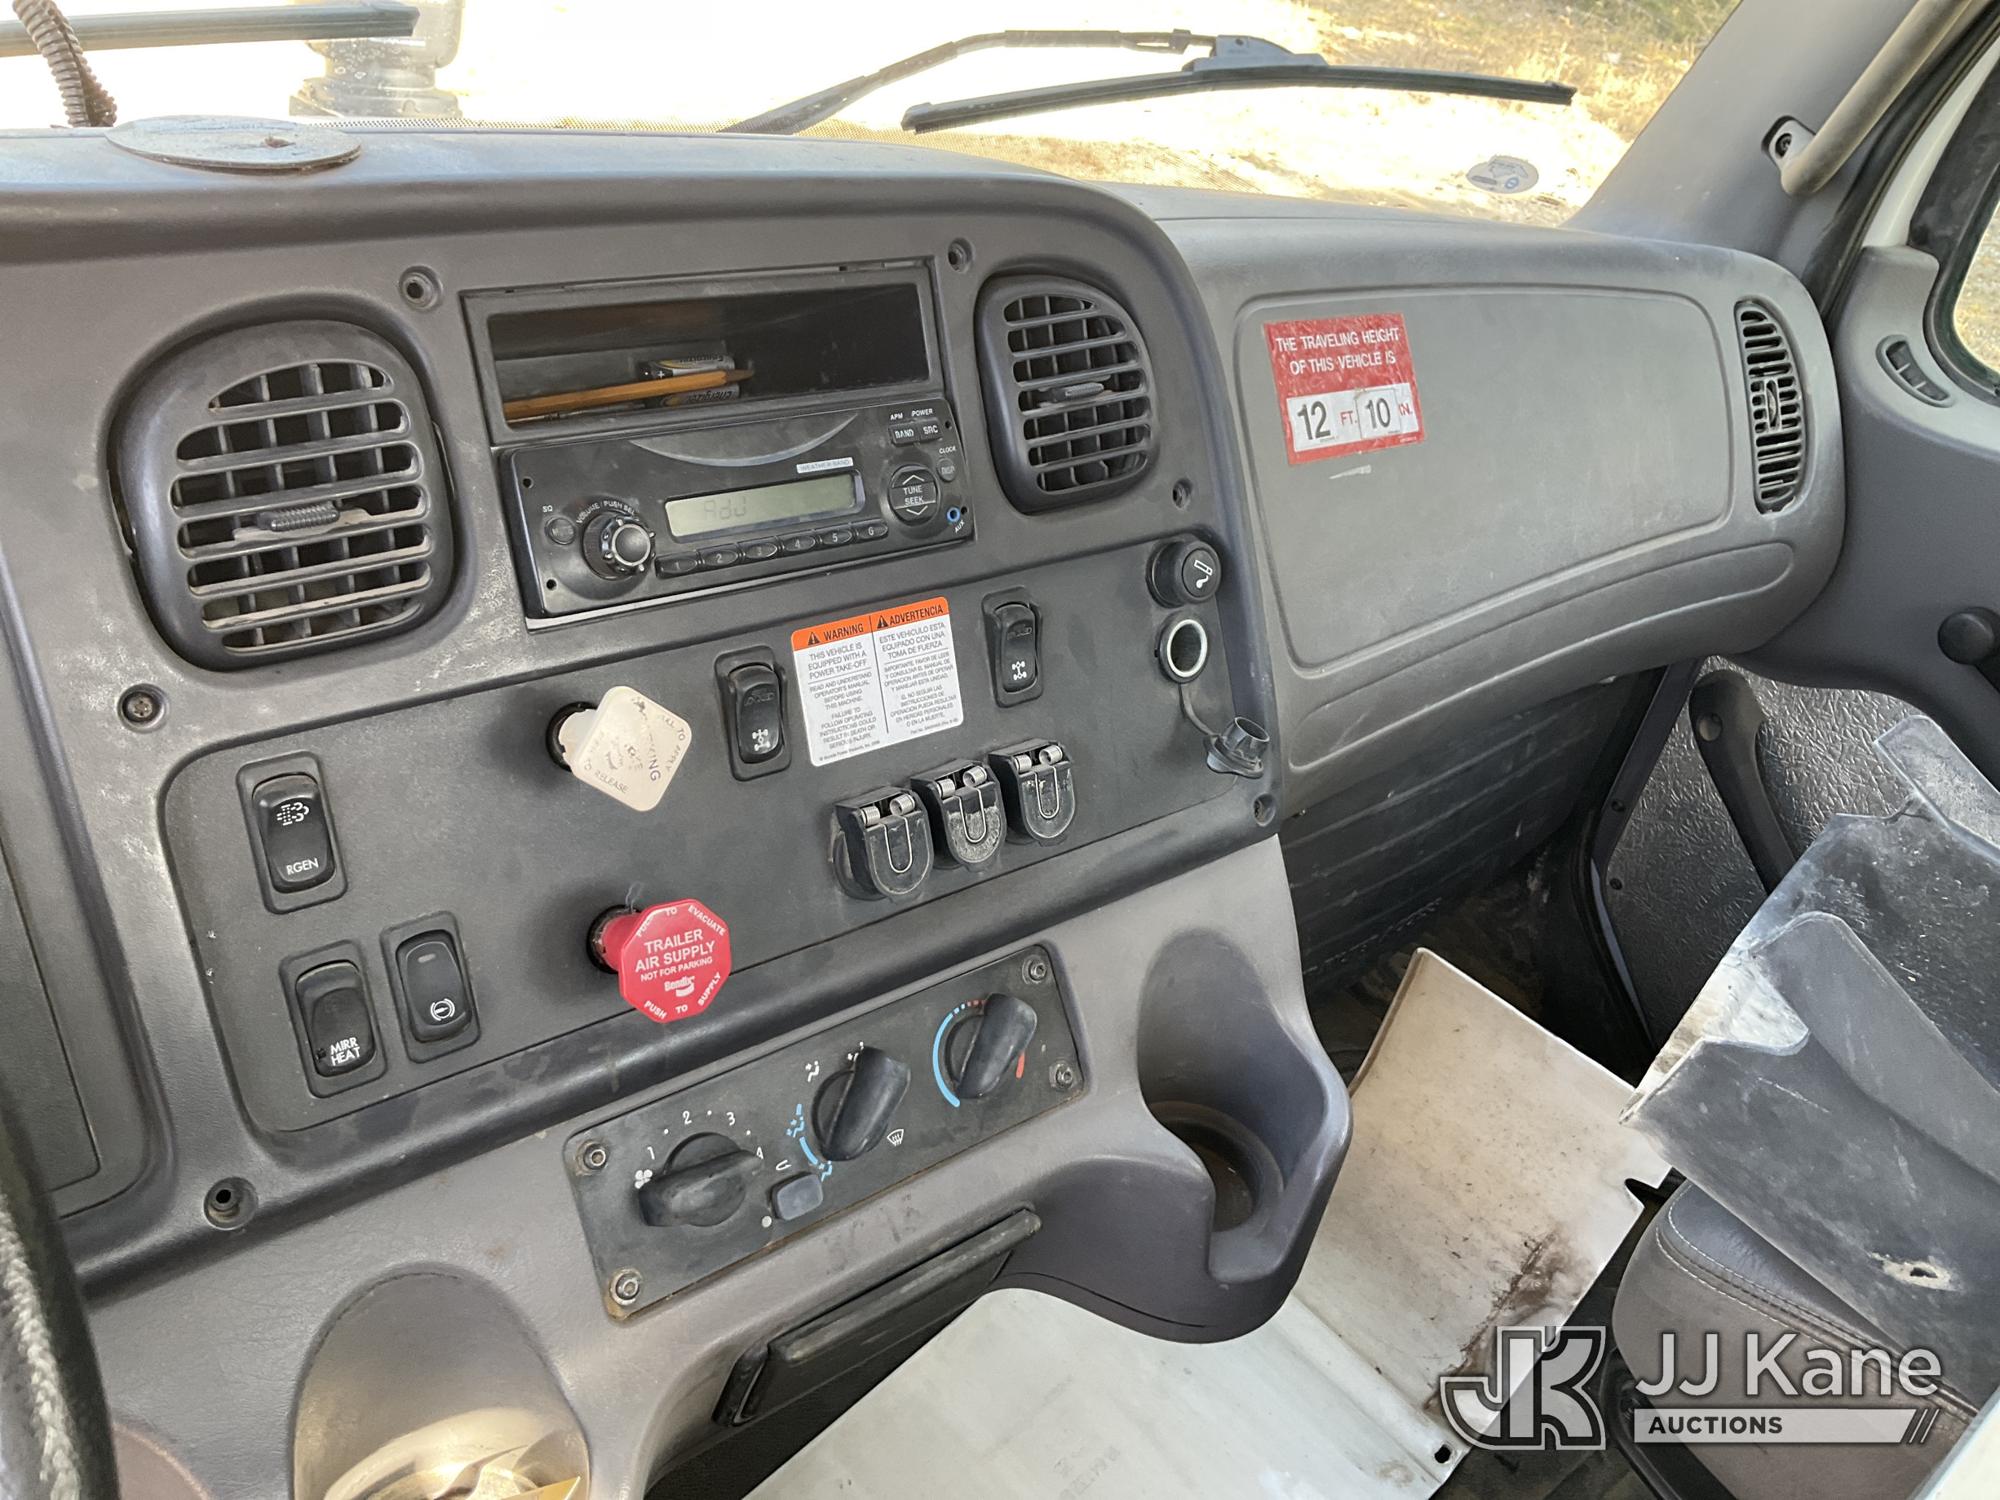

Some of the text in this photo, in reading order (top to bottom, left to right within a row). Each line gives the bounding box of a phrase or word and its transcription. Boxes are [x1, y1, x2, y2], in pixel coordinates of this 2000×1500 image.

[1276, 327, 1399, 352] THE TRAVELING HEIGHT
[1290, 351, 1396, 375] OF THIS VEHICLE IS
[911, 408, 933, 417] POWER
[1297, 401, 1331, 440] 12
[1340, 411, 1358, 425] FT.
[1365, 398, 1391, 429] 10
[894, 425, 939, 439] BAND SRC
[938, 445, 957, 454] CLOCK
[903, 486, 923, 495] TUNE
[603, 500, 622, 509] PUSH
[905, 496, 924, 505] SEEK
[576, 502, 600, 524] VOLUME
[868, 527, 874, 536] 6
[954, 520, 965, 533] AUX
[795, 539, 801, 549] 4
[832, 533, 838, 542] 5
[716, 553, 723, 563] 2
[890, 604, 943, 625] ADVERTENCIA
[824, 623, 864, 641] WARNING
[879, 633, 896, 644] ESTE
[930, 622, 945, 631] ESTA
[809, 641, 863, 660] THIS VEHICLE IS
[882, 631, 945, 652] EQUIPADO CON UNA
[887, 640, 943, 659] TOMA DE FUERZA
[808, 656, 842, 671] EQUIPPED
[843, 651, 860, 662] WITH
[809, 658, 867, 680] POWER TAKE-OFF
[825, 680, 837, 689] AND
[677, 728, 686, 741] TO
[286, 858, 319, 876] RGEN
[664, 907, 677, 916] TO
[688, 905, 726, 936] EVACUATE
[644, 929, 703, 954] TRAILER
[635, 940, 716, 973] AIR SUPPLY
[640, 956, 713, 982] NOT FOR PARKING
[644, 971, 721, 1020] PUSH TO SUPPLY
[330, 1036, 359, 1055] MIRR
[330, 1047, 361, 1067] HEAT
[682, 1110, 692, 1125] 2
[726, 1112, 736, 1126] 3
[647, 1146, 655, 1160] 1
